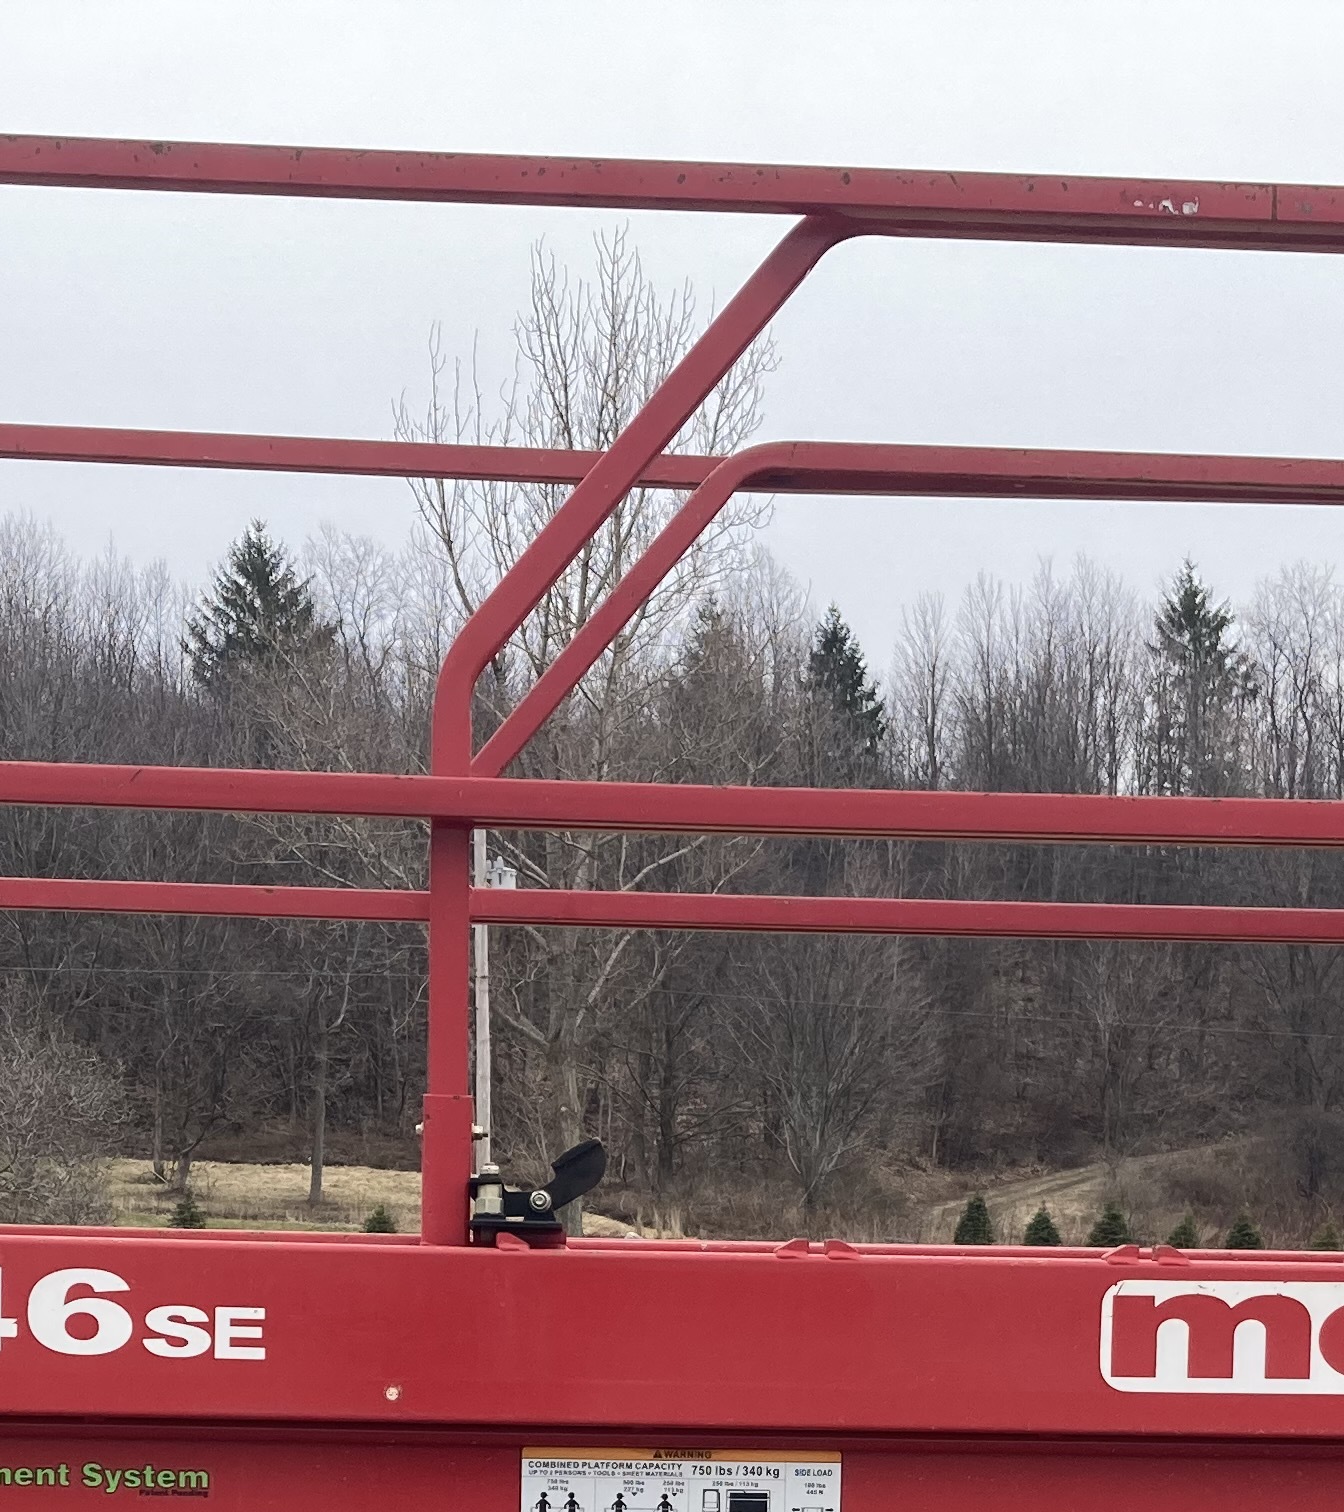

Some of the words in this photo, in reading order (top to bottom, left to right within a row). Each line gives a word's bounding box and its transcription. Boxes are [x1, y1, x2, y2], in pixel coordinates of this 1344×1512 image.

[663, 1450, 712, 1460] WARNING
[528, 1460, 579, 1470] COMBINED
[581, 1461, 633, 1470] PLATFORM
[634, 1462, 683, 1471] CAPACITY
[691, 1465, 712, 1476] 750
[715, 1465, 733, 1476] lbs
[735, 1465, 741, 1476] /
[742, 1465, 763, 1476] 340
[765, 1466, 780, 1479] kg
[794, 1468, 811, 1477] SIDE
[812, 1468, 833, 1477] LOAD
[81, 1461, 210, 1495] System
